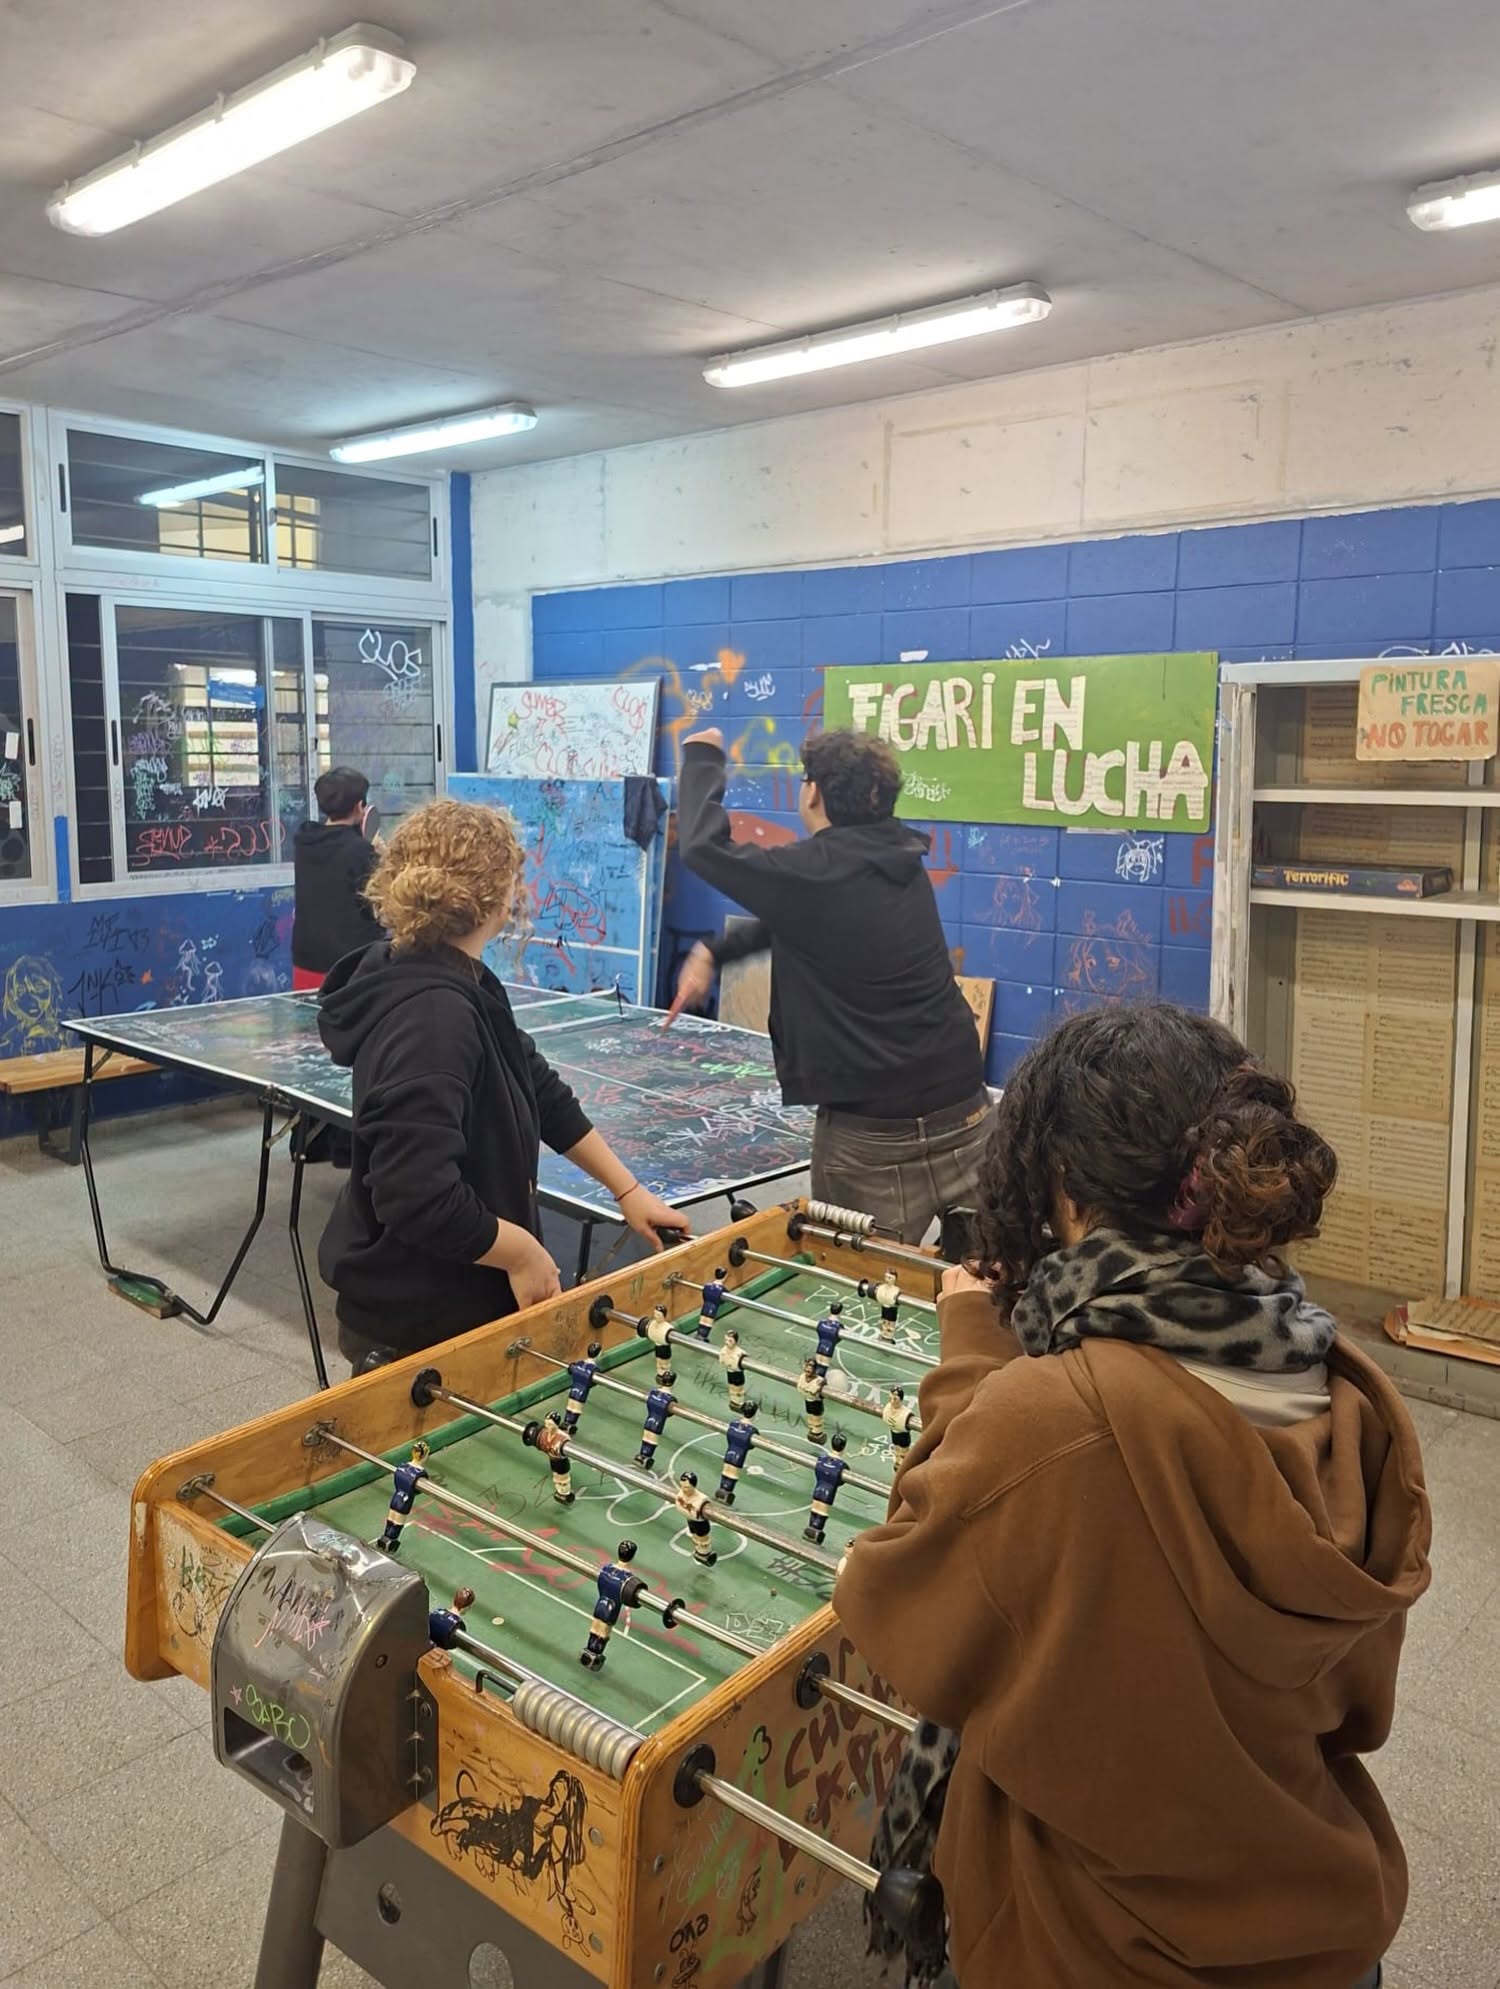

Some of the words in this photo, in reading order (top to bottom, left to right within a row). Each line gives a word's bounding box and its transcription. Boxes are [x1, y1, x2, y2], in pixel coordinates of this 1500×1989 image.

[1010, 675, 1087, 750] EN
[1401, 692, 1488, 718] FRESCA
[1364, 721, 1407, 750] NO
[1412, 720, 1490, 748] TOCAR
[1022, 740, 1209, 820] LUCHA
